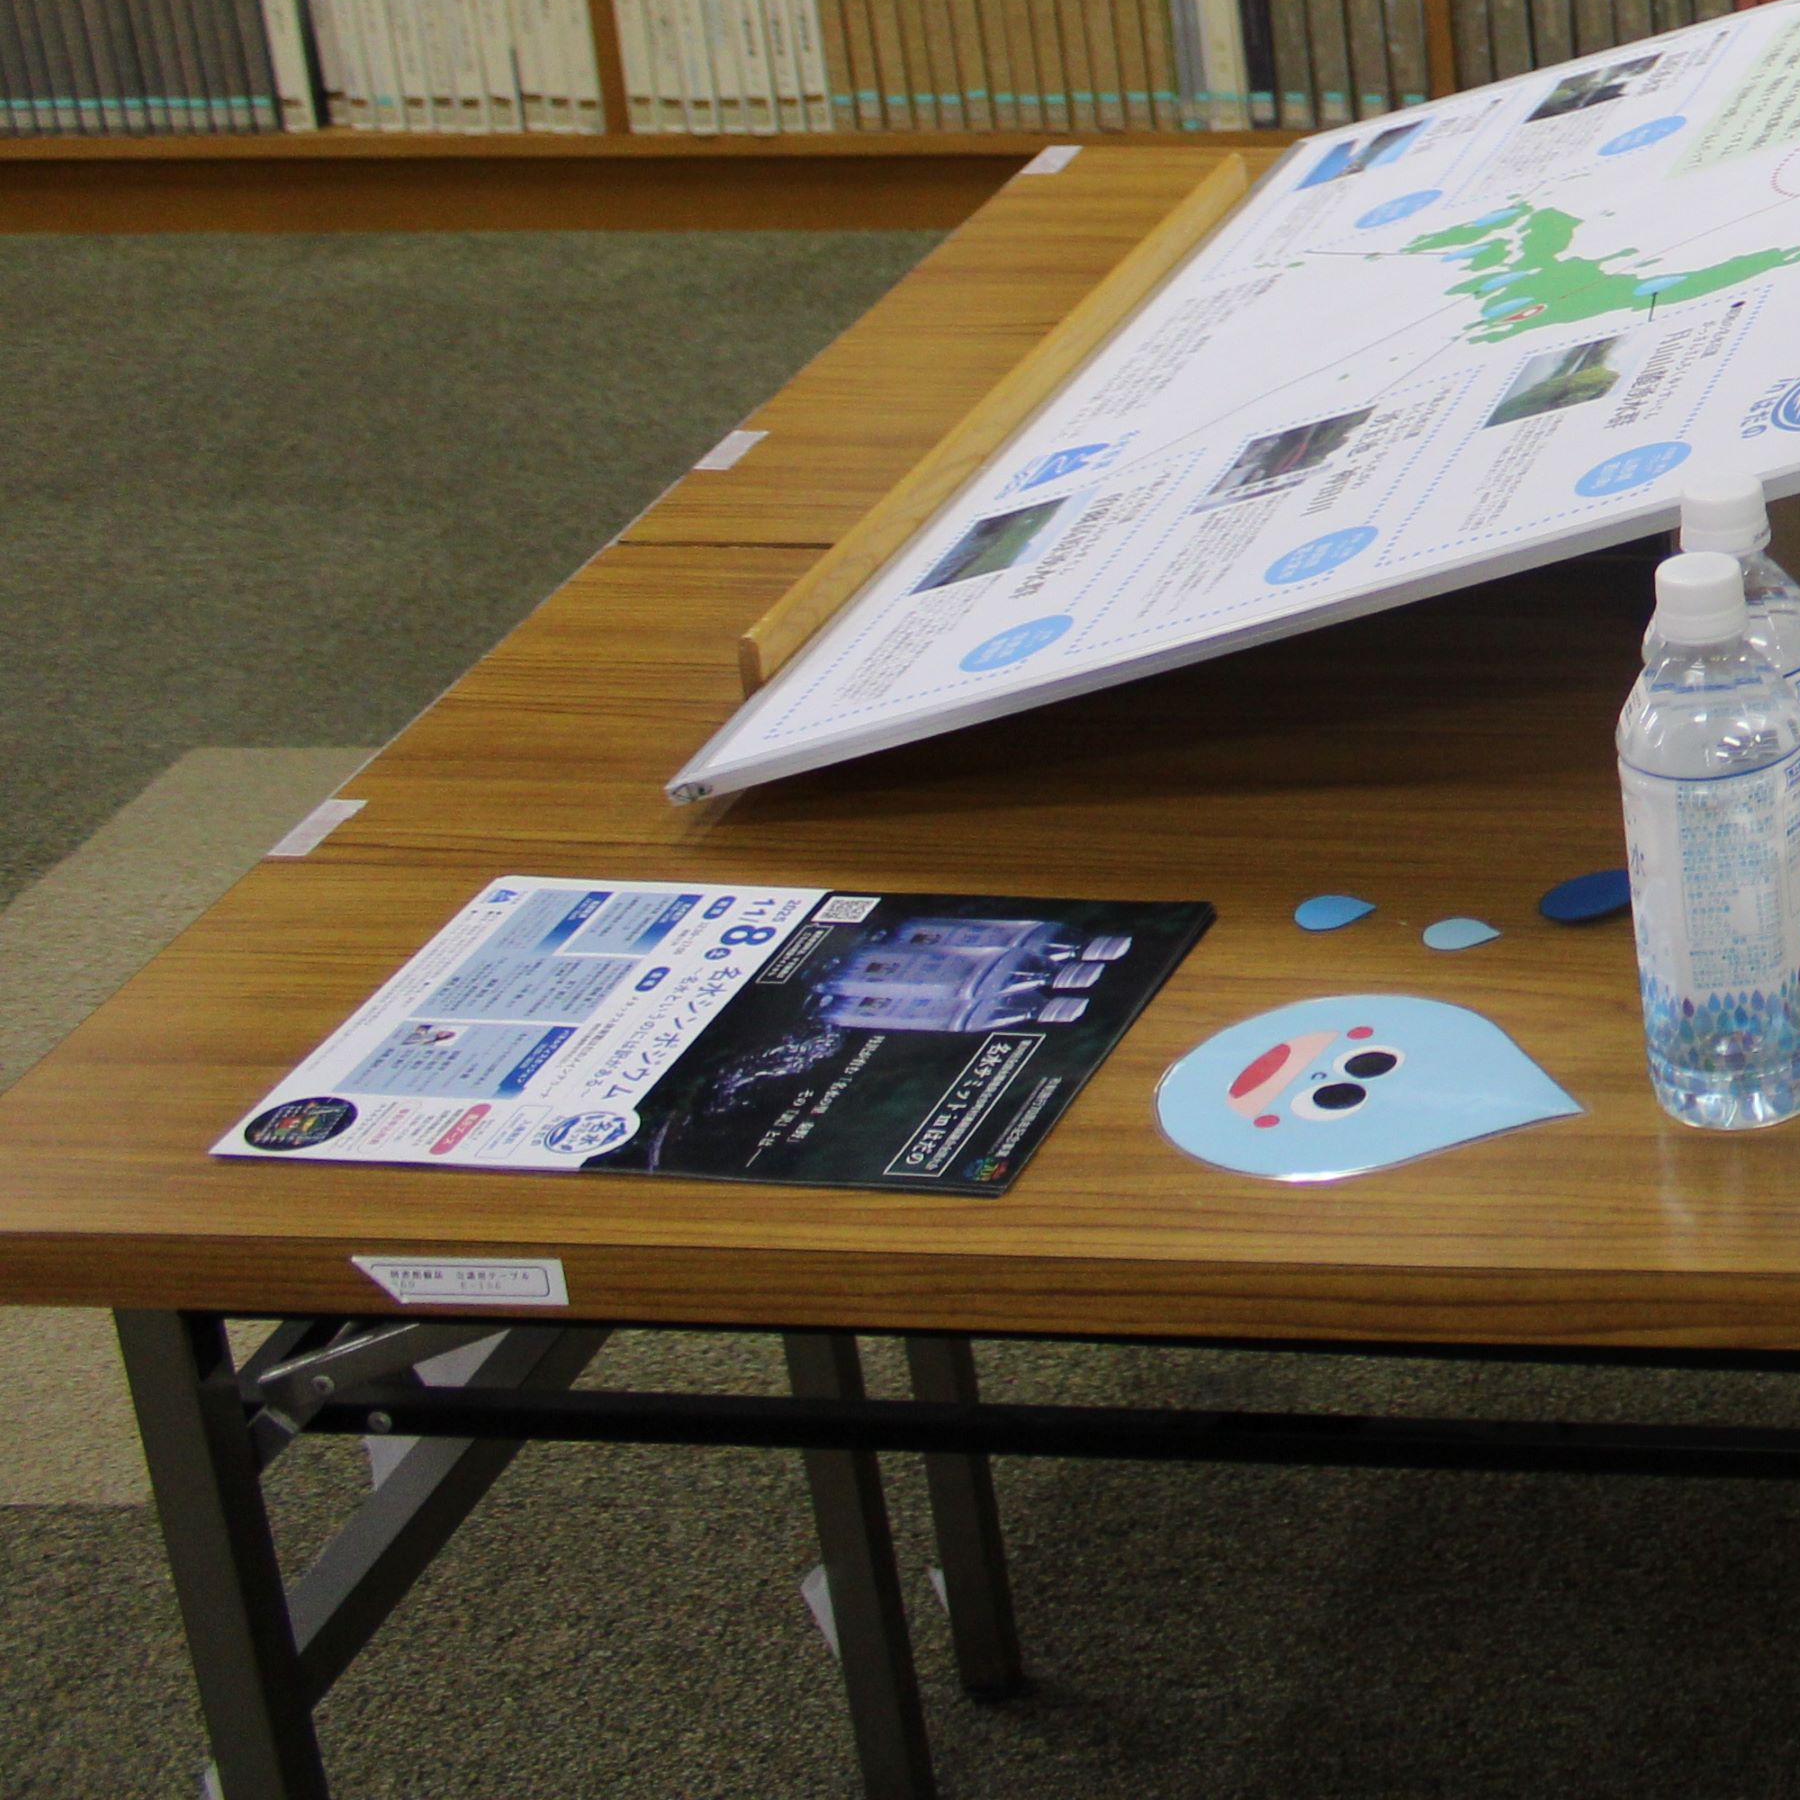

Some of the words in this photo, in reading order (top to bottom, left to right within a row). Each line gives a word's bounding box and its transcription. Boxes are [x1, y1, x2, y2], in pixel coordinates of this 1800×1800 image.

[595, 967, 746, 1101] 名水シンポジウム
